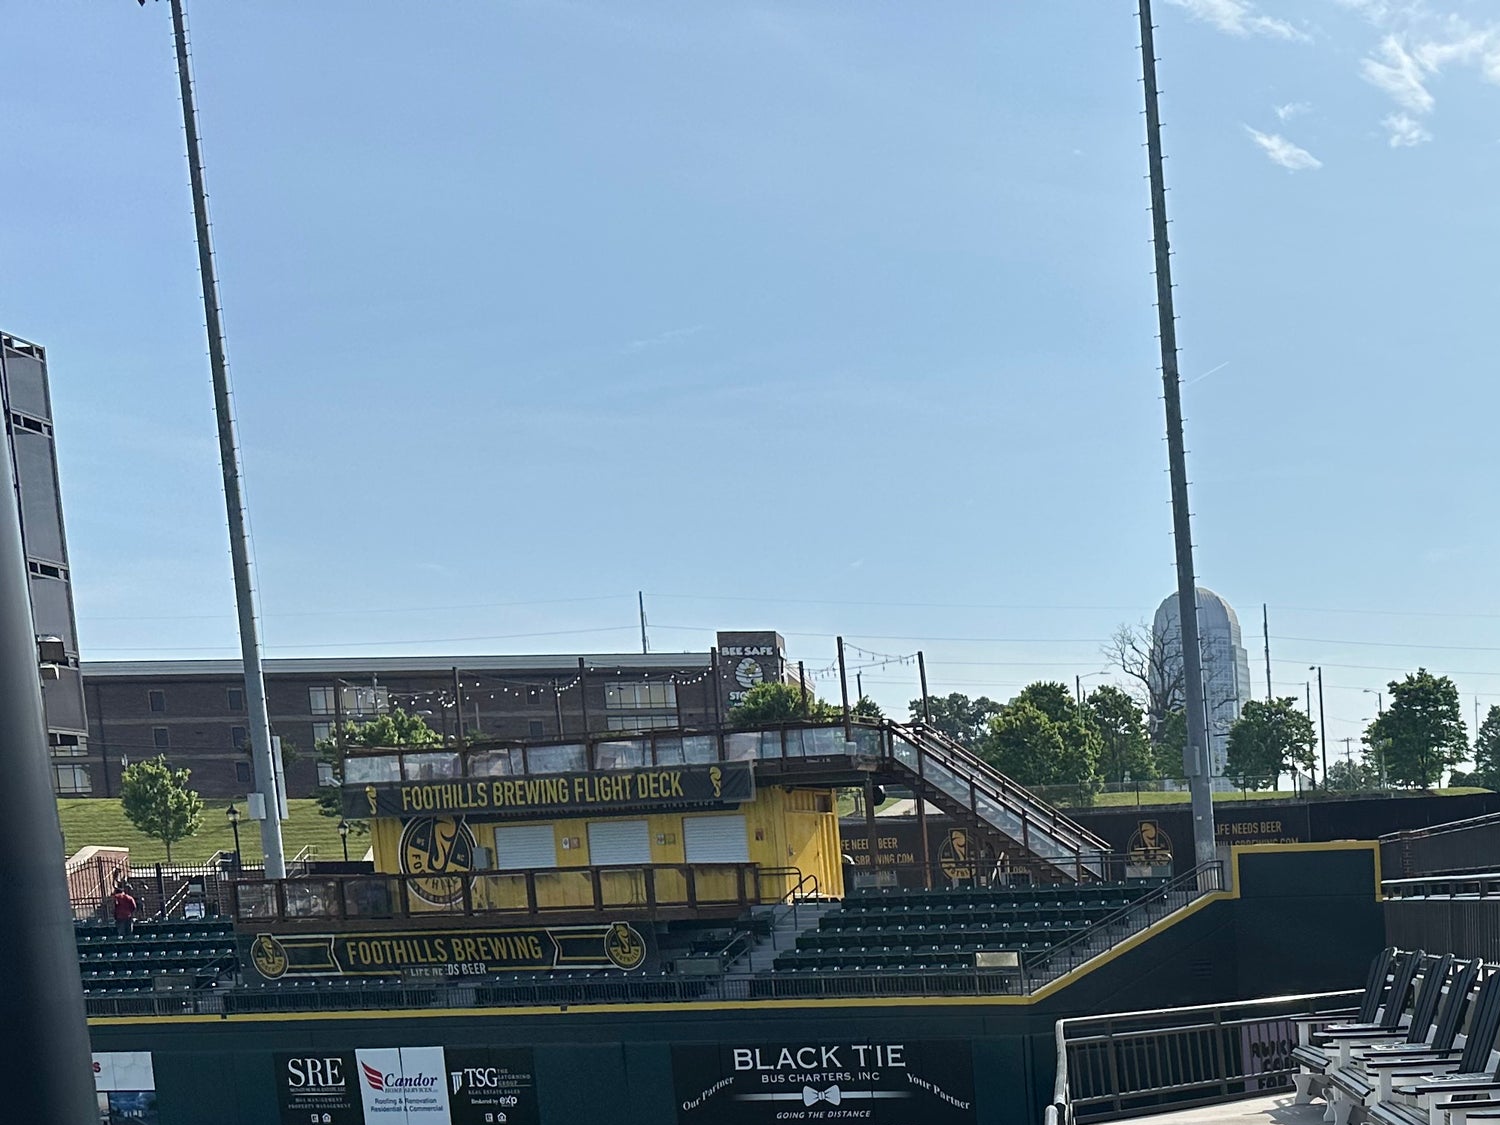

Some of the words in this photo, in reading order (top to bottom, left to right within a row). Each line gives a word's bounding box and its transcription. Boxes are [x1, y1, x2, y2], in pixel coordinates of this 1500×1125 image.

[722, 647, 742, 656] BEE
[745, 646, 773, 655] SAFE
[402, 783, 487, 810] FOOTHILLS
[493, 778, 568, 806] BREWING
[574, 775, 631, 802] FLIGHT
[637, 772, 684, 798] DECK
[1232, 822, 1259, 834] NEEDS
[1260, 821, 1282, 833] BEER
[878, 837, 898, 849] BEER
[346, 938, 448, 964] FOOTHILLS
[452, 936, 542, 961] BREWING
[461, 962, 486, 975] BEER
[733, 1046, 842, 1070] BLACK
[852, 1045, 906, 1067] TIE
[288, 1058, 345, 1087] SRE
[384, 1072, 438, 1087] Candor
[464, 1068, 497, 1087] TSG
[762, 1074, 785, 1083] BUS
[788, 1072, 854, 1082] CHARTERS,
[858, 1072, 880, 1080] INC
[682, 1098, 700, 1110] Our
[702, 1076, 734, 1101] Partner
[907, 1073, 932, 1090] Your
[933, 1084, 970, 1110] Partner
[827, 1110, 871, 1118] DISTANCE
